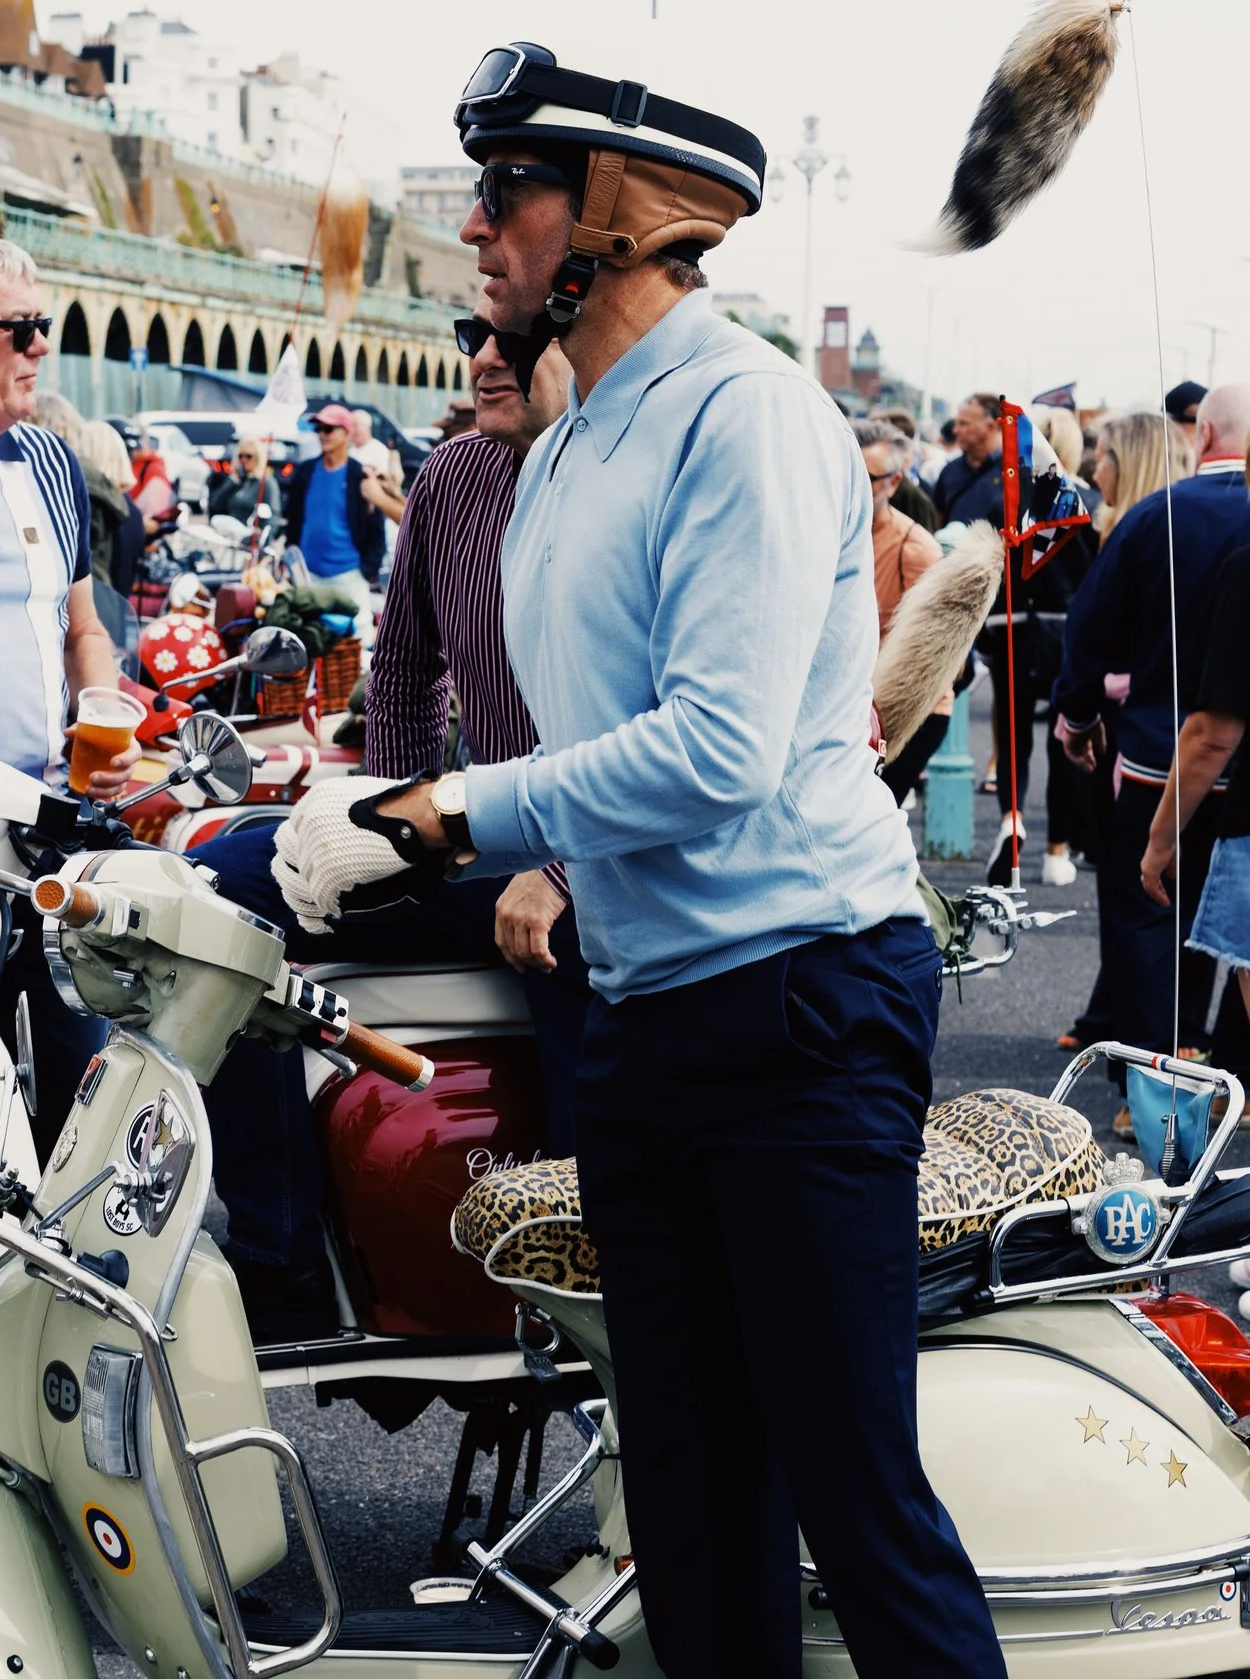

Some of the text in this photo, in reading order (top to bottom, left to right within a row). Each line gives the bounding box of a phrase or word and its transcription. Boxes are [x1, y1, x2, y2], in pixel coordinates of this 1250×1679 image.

[1103, 1193, 1152, 1246] RAC
[45, 1372, 76, 1413] GB
[1105, 1599, 1232, 1636] Vespa
